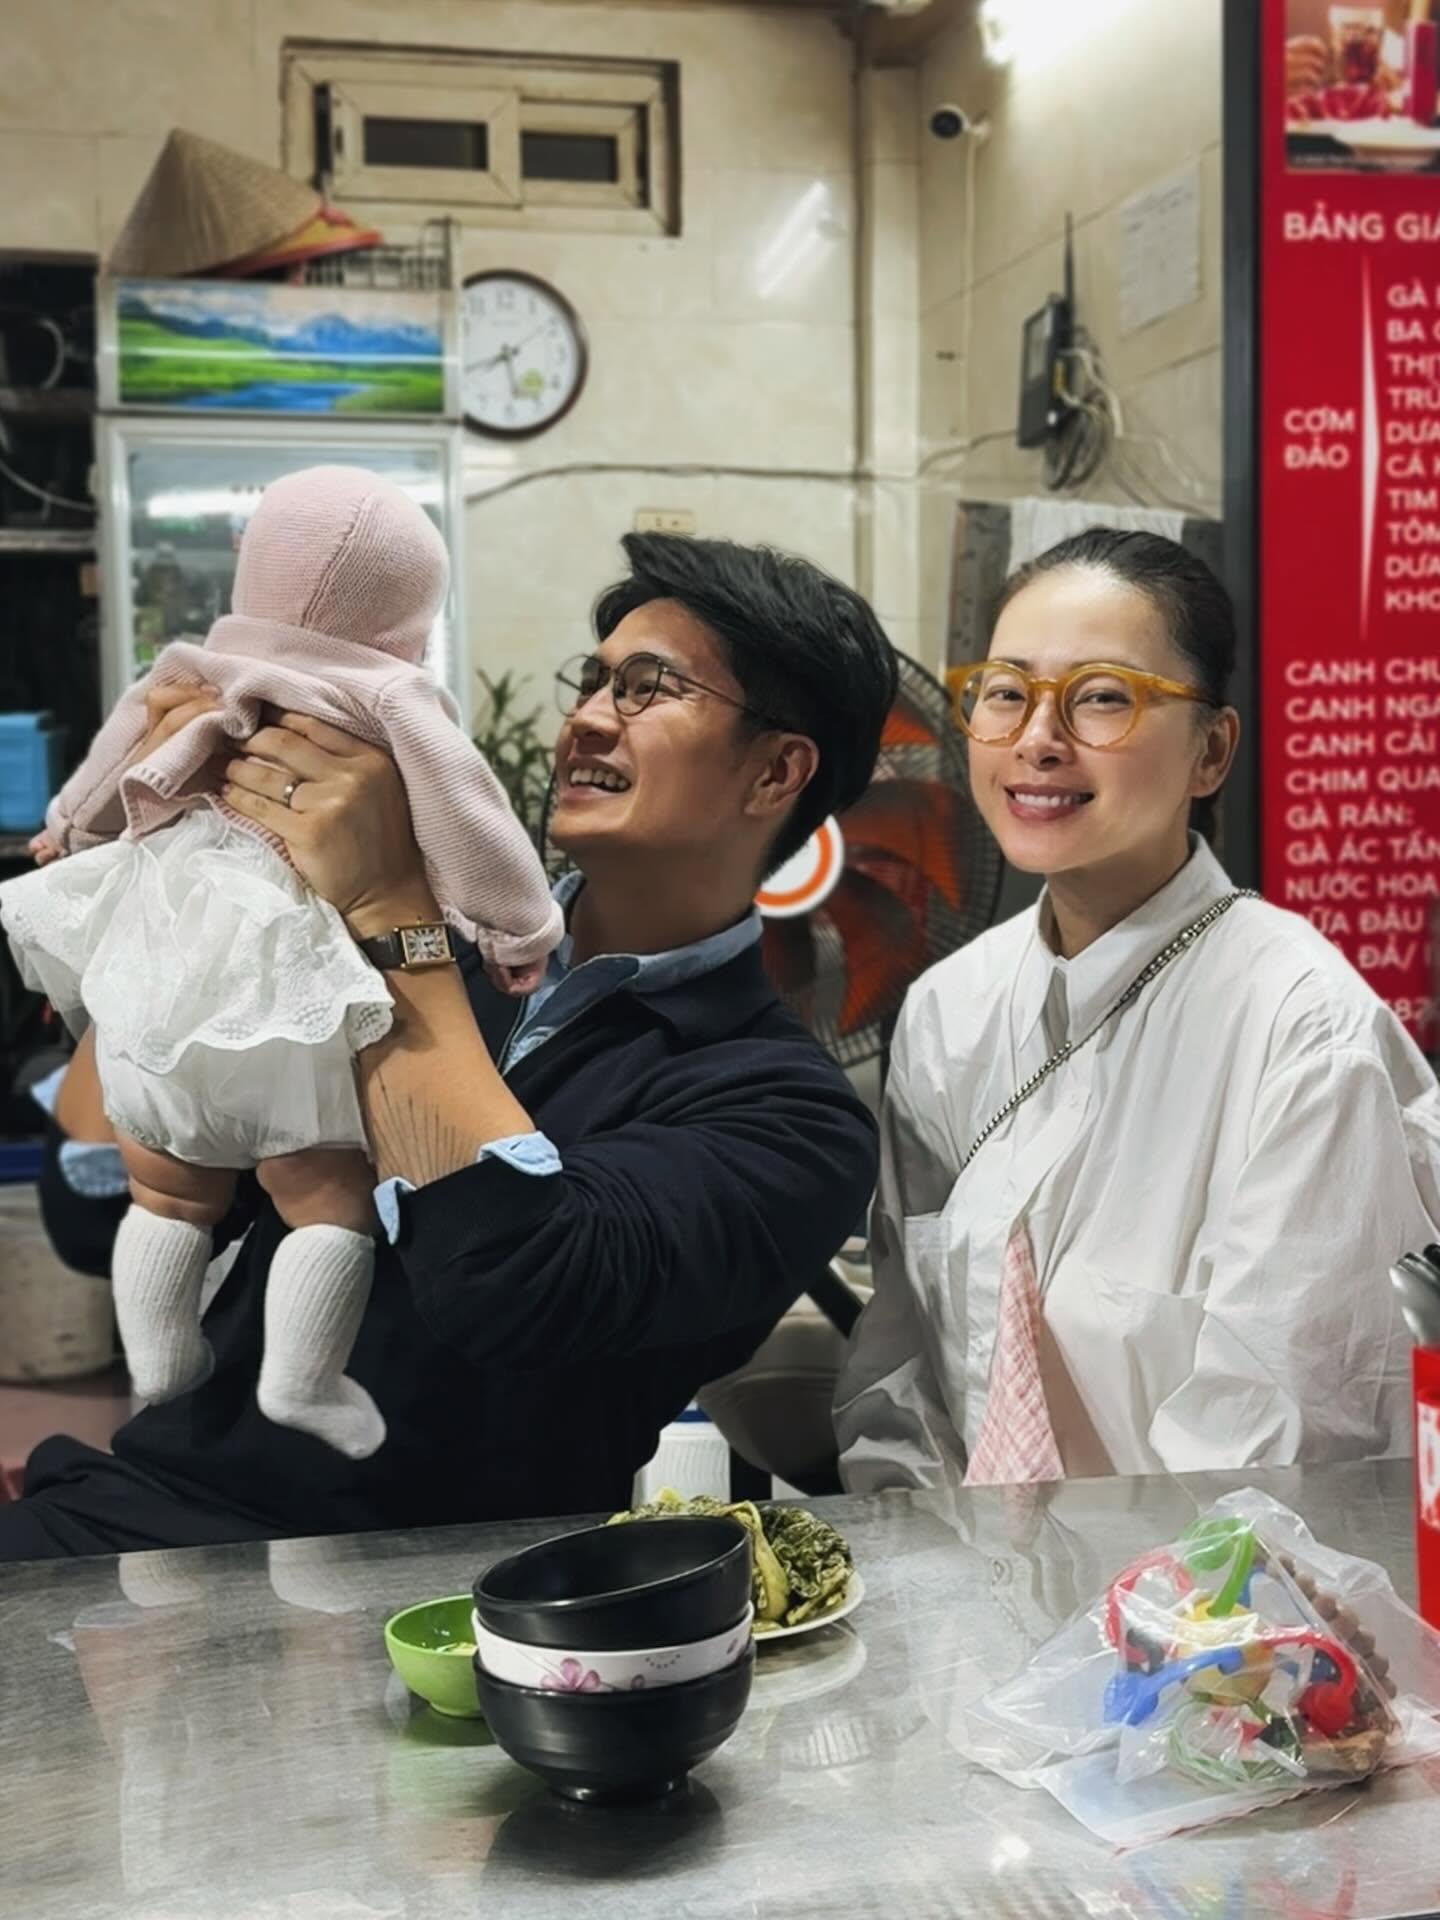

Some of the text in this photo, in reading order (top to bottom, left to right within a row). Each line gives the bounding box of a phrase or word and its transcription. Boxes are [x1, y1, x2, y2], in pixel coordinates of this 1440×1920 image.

[1283, 201, 1385, 241] BẢNG
[1386, 278, 1428, 308] GÀ
[1386, 319, 1425, 343] BA
[1284, 404, 1355, 433] CƠM
[1386, 487, 1438, 511] TIM
[1285, 660, 1376, 686] CANH
[1285, 696, 1376, 723] CANH
[1285, 732, 1376, 759] CANH
[1285, 768, 1369, 795] CHIM
[1286, 797, 1330, 830] GÀ
[1285, 835, 1330, 866] GÀ
[1338, 833, 1380, 862] ÁC
[1285, 870, 1370, 901] NƯỚC
